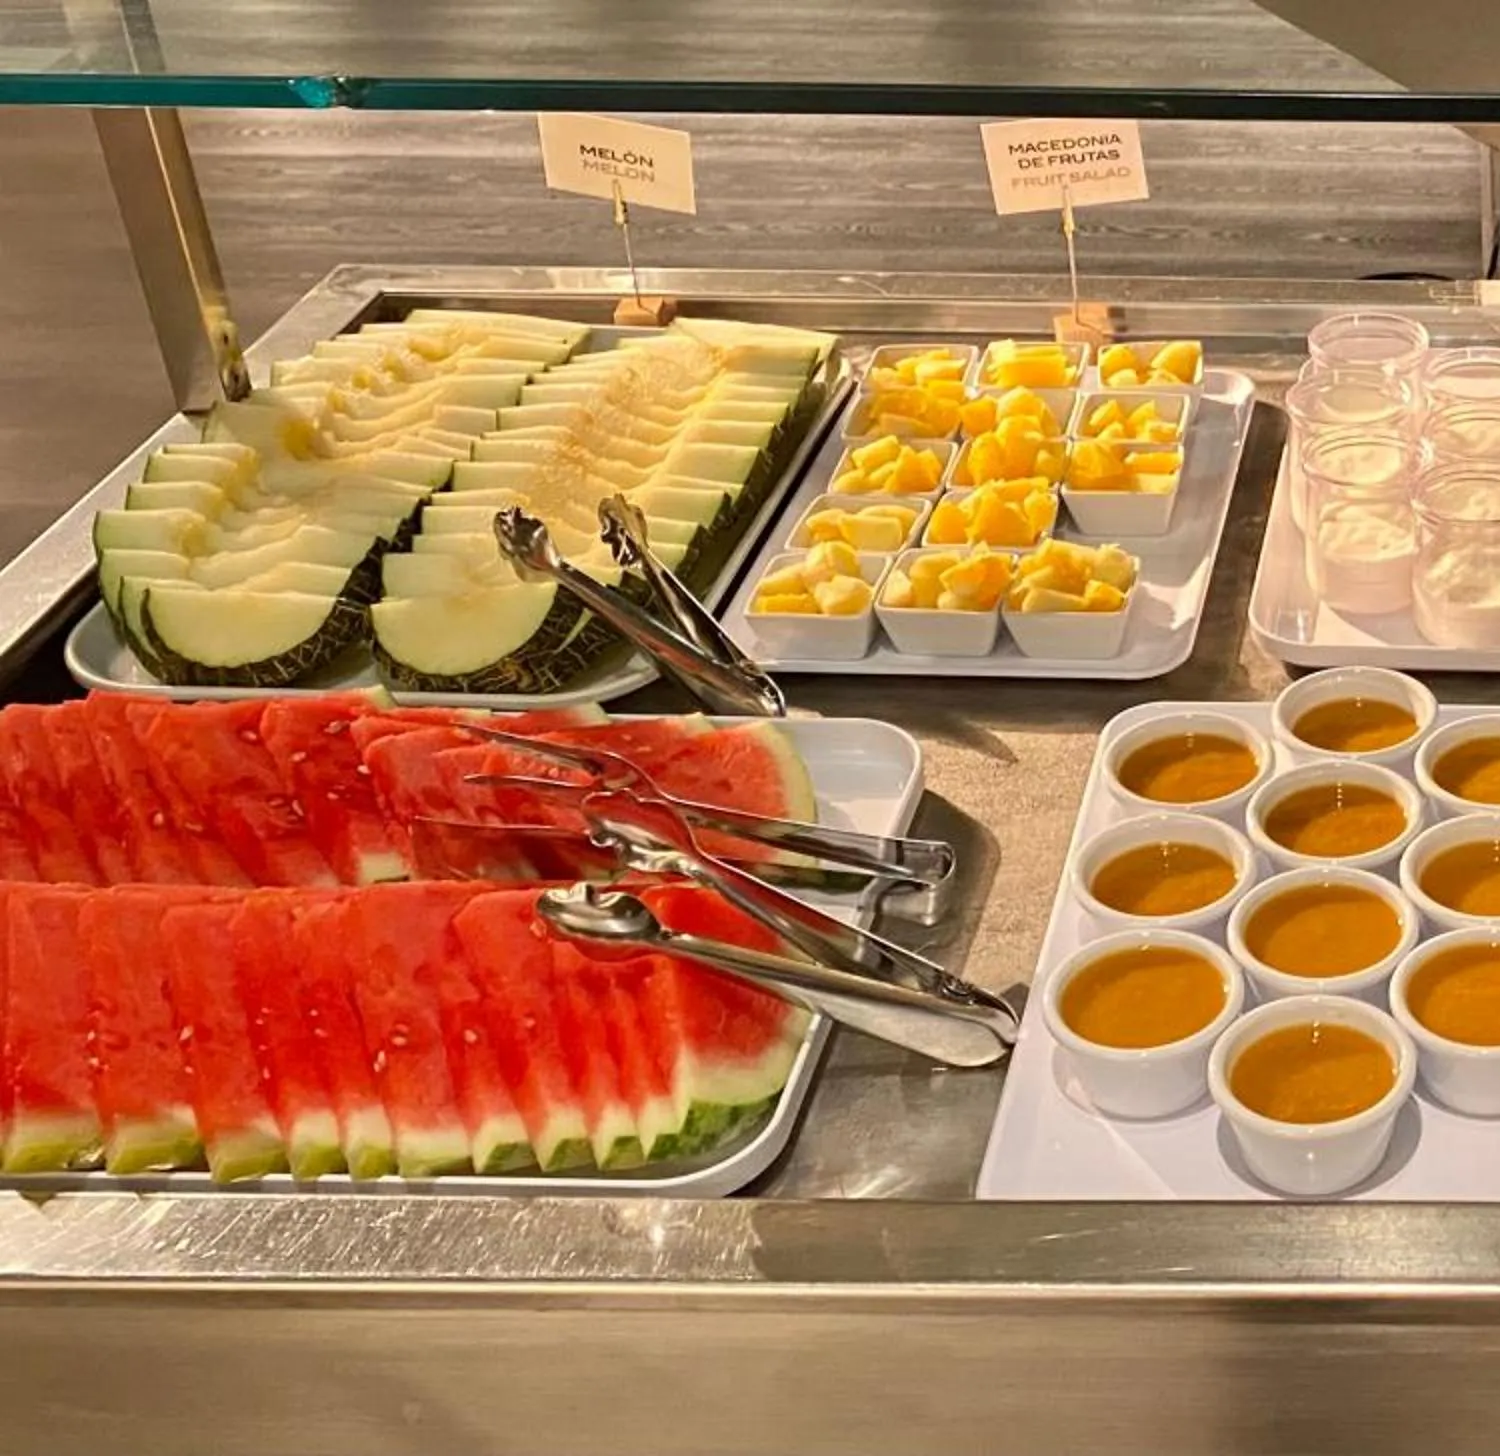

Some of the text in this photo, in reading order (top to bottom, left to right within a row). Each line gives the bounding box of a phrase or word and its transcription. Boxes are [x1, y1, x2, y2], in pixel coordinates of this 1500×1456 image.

[580, 144, 653, 168] MELÓN
[1008, 133, 1123, 156] MACEDONIA
[582, 159, 655, 182] MELON
[1017, 149, 1120, 170] DE FRUTAS
[1011, 166, 1132, 190] FRUIT SALAD
